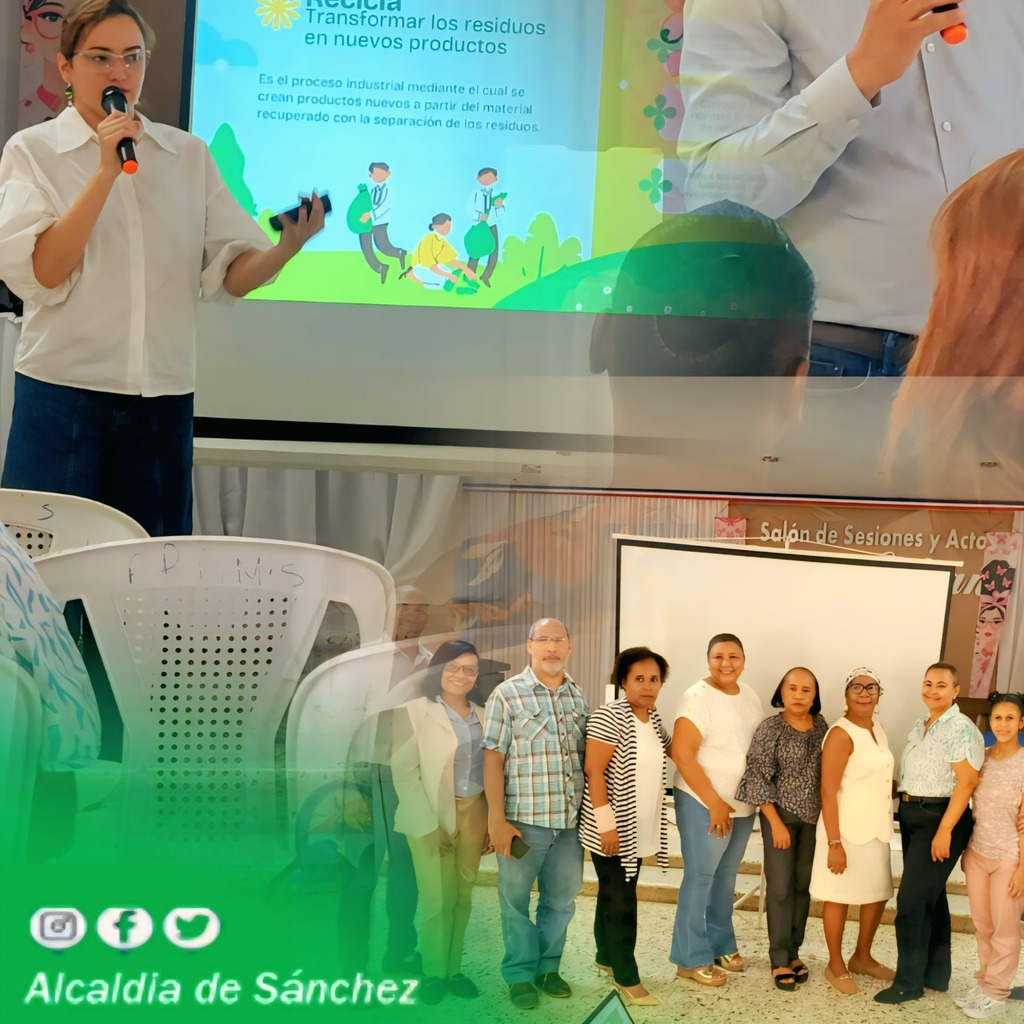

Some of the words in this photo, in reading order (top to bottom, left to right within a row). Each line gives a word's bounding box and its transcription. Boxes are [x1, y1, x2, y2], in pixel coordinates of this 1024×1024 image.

[305, 8, 426, 30] Transformar
[431, 14, 458, 31] los
[464, 17, 546, 36] residuos
[304, 32, 327, 47] en
[333, 33, 403, 50] nuevos
[409, 36, 508, 55] productos
[258, 74, 274, 85] Es
[277, 75, 288, 86] el
[291, 77, 343, 90] proceso
[346, 77, 405, 92] industrial
[408, 81, 466, 95] mediante
[468, 84, 479, 95] el
[482, 85, 508, 97] cual
[511, 88, 525, 98] se
[257, 92, 294, 104] crean
[297, 93, 362, 108] productos
[365, 98, 410, 110] nuevos
[413, 100, 421, 110] a
[424, 98, 457, 113] partir
[461, 100, 480, 112] del
[483, 103, 533, 115] material
[257, 109, 330, 123] recuperado
[333, 113, 356, 124] con
[360, 114, 370, 125] la
[374, 114, 442, 128] separación
[445, 117, 460, 128] de
[761, 520, 810, 543] Salón
[815, 522, 837, 544] de
[844, 524, 923, 547] Sesiones
[928, 533, 941, 554] y
